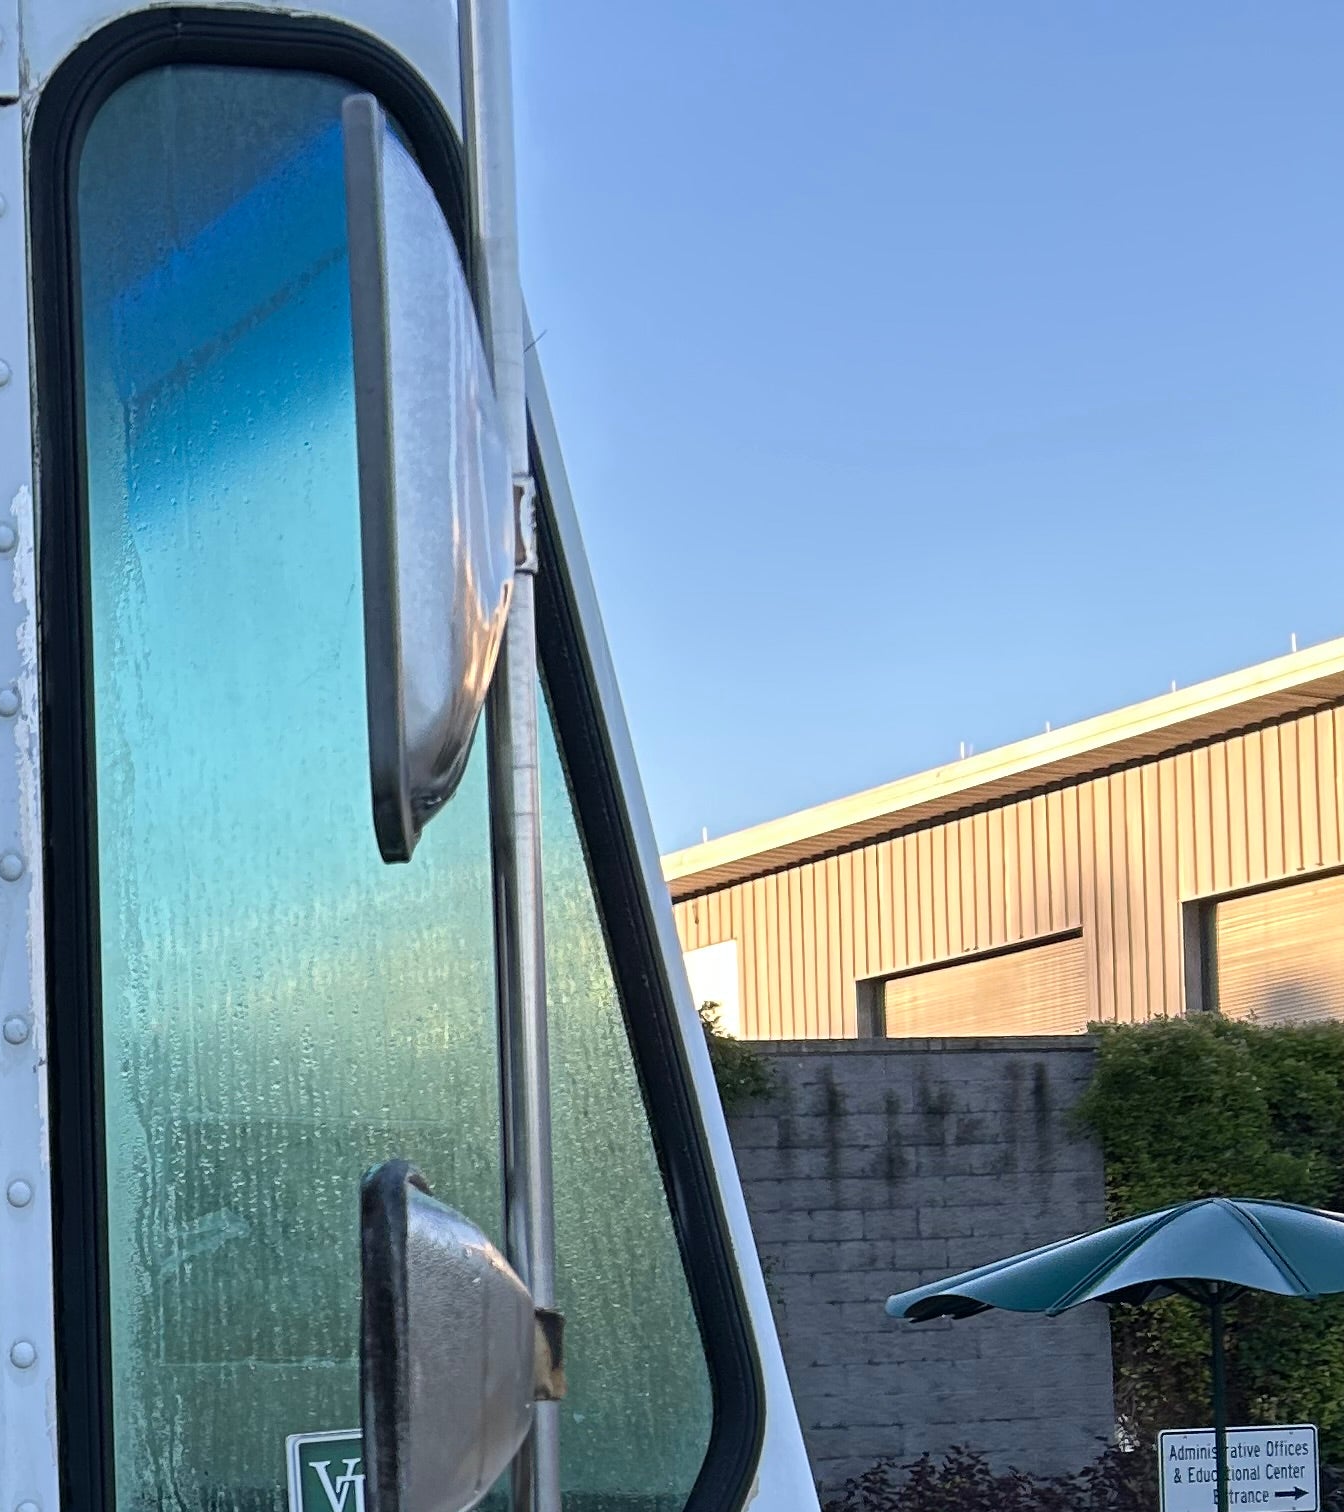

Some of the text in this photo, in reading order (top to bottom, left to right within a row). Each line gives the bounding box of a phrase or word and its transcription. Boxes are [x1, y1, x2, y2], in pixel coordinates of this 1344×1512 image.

[1169, 1440, 1309, 1461] Adminisative Offices
[1174, 1464, 1305, 1484] & Educional Center
[1214, 1488, 1269, 1505] Etrance
